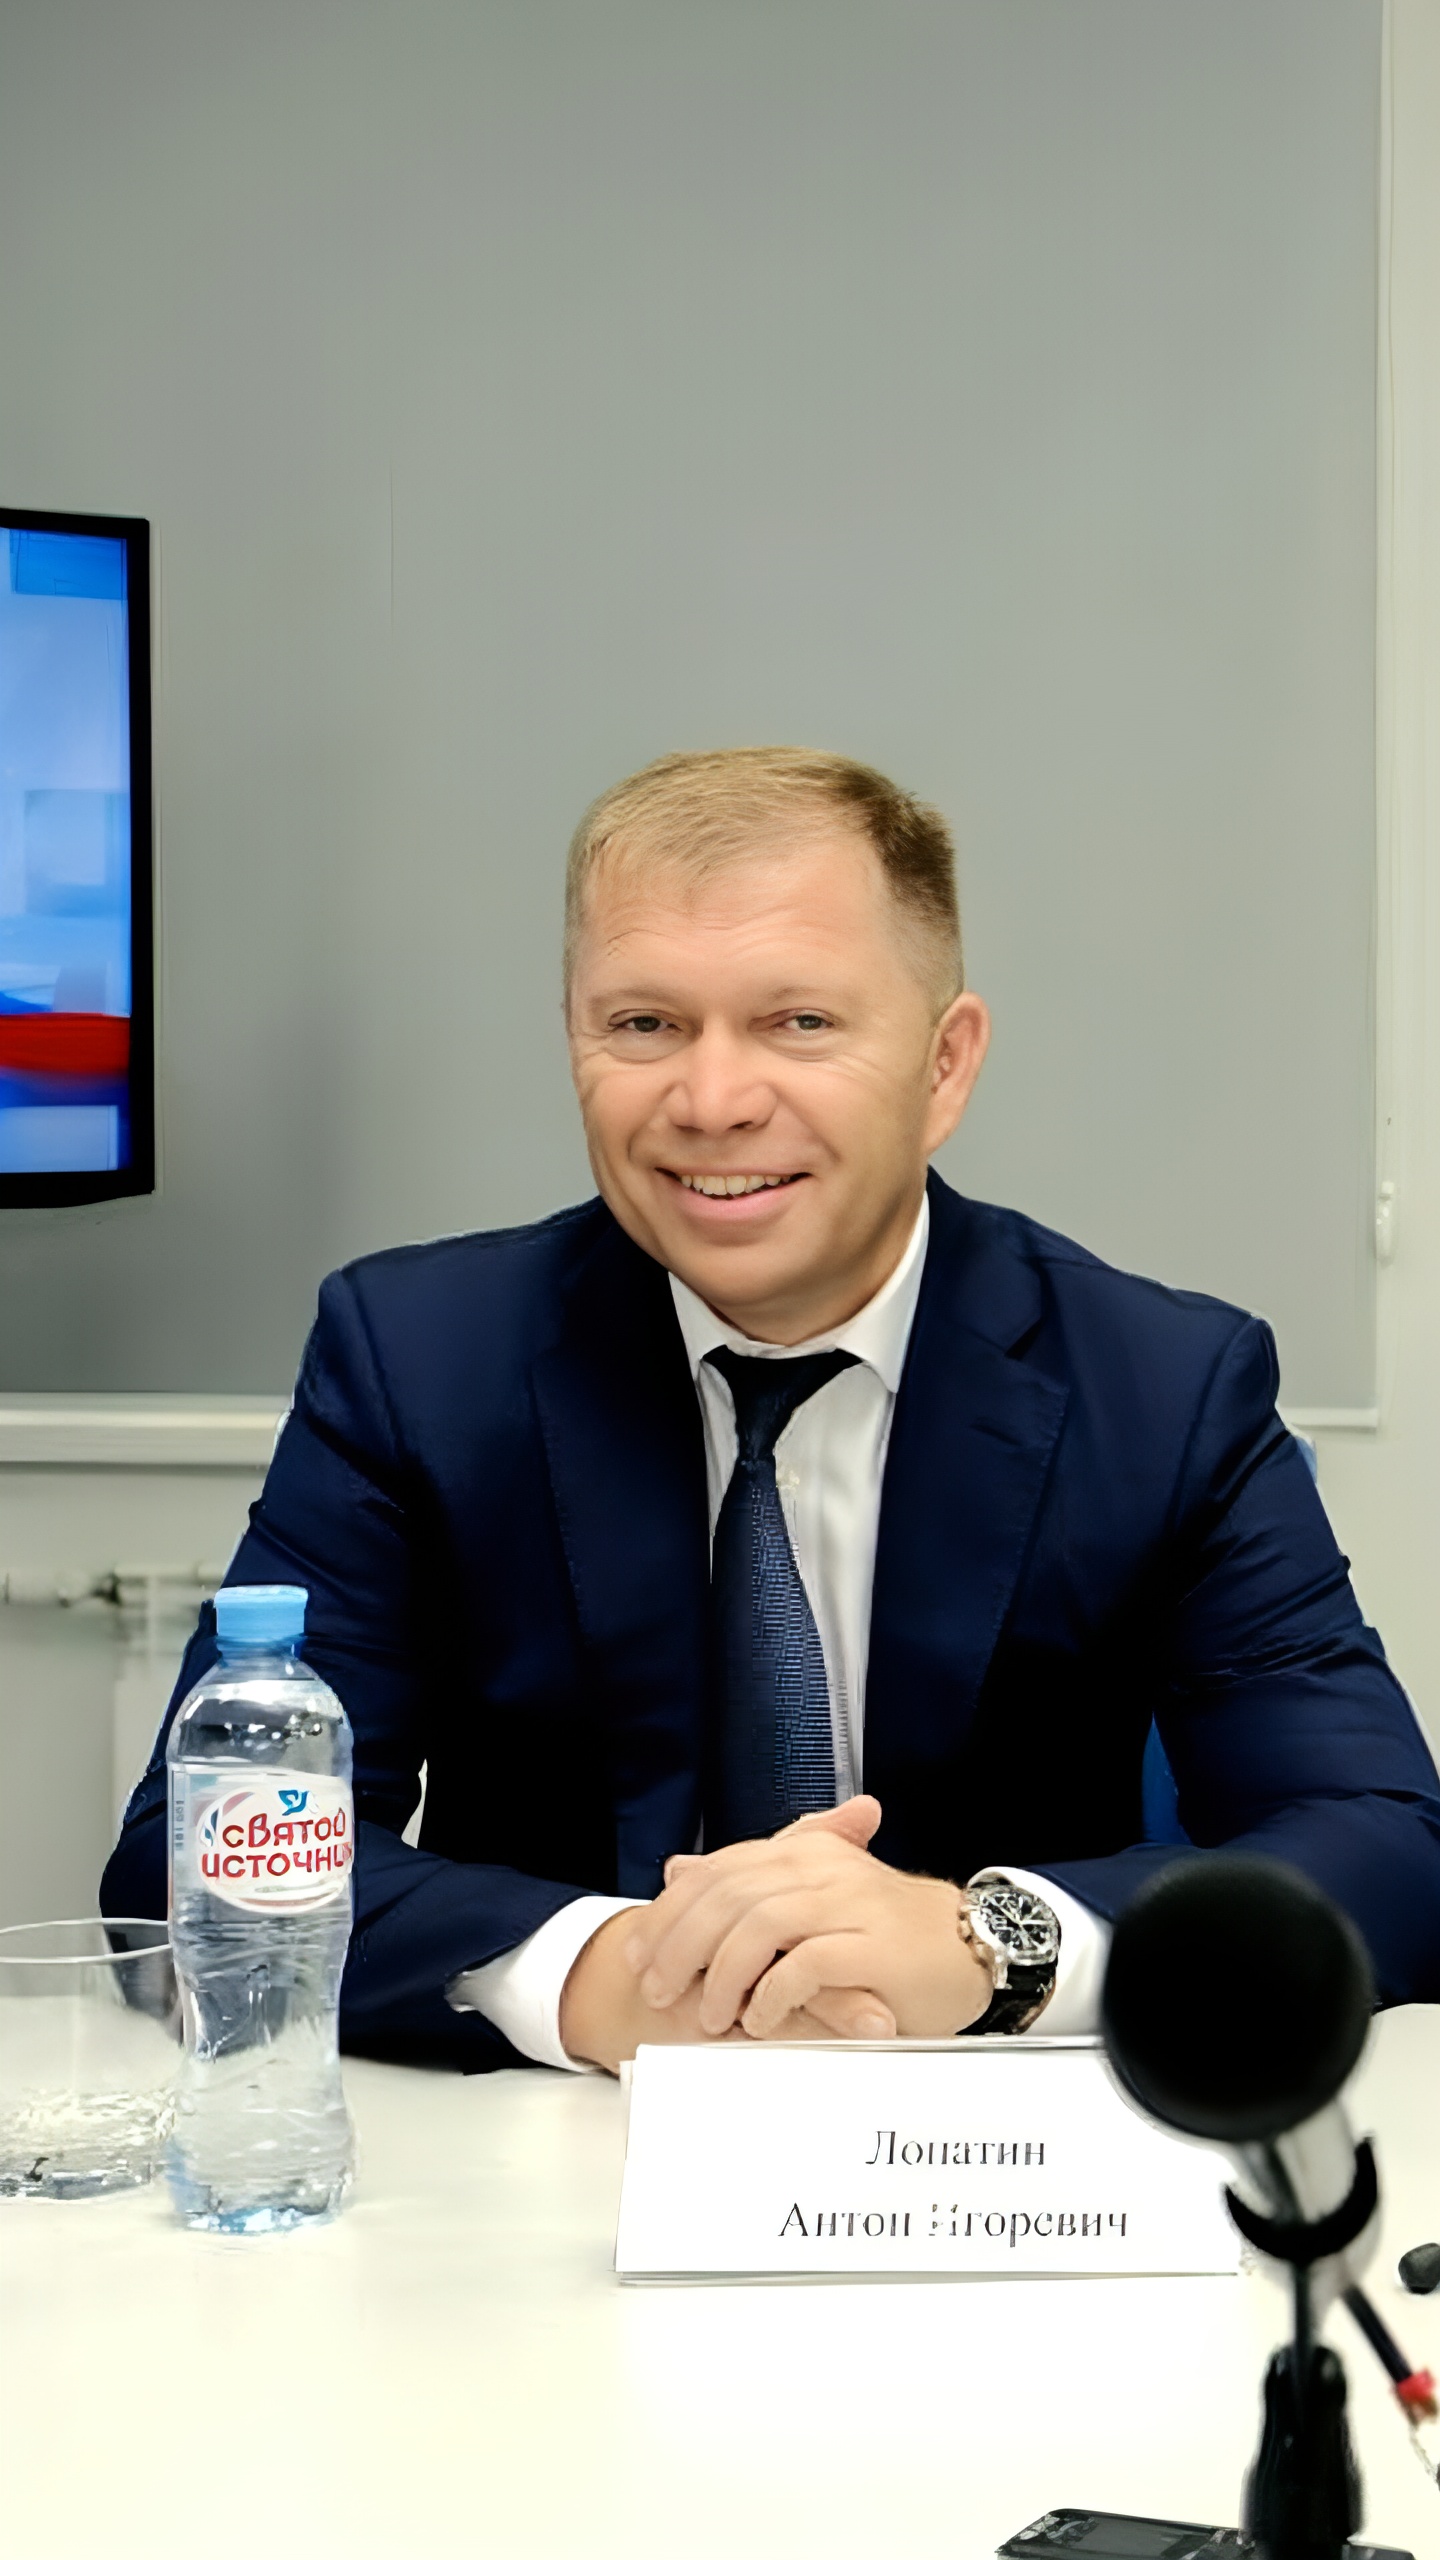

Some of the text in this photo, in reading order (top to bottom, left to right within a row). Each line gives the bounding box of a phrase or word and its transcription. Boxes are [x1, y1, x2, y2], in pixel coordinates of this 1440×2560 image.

[864, 2130, 1045, 2166] Лопатин
[777, 2202, 1127, 2248] Антон Игоревич
